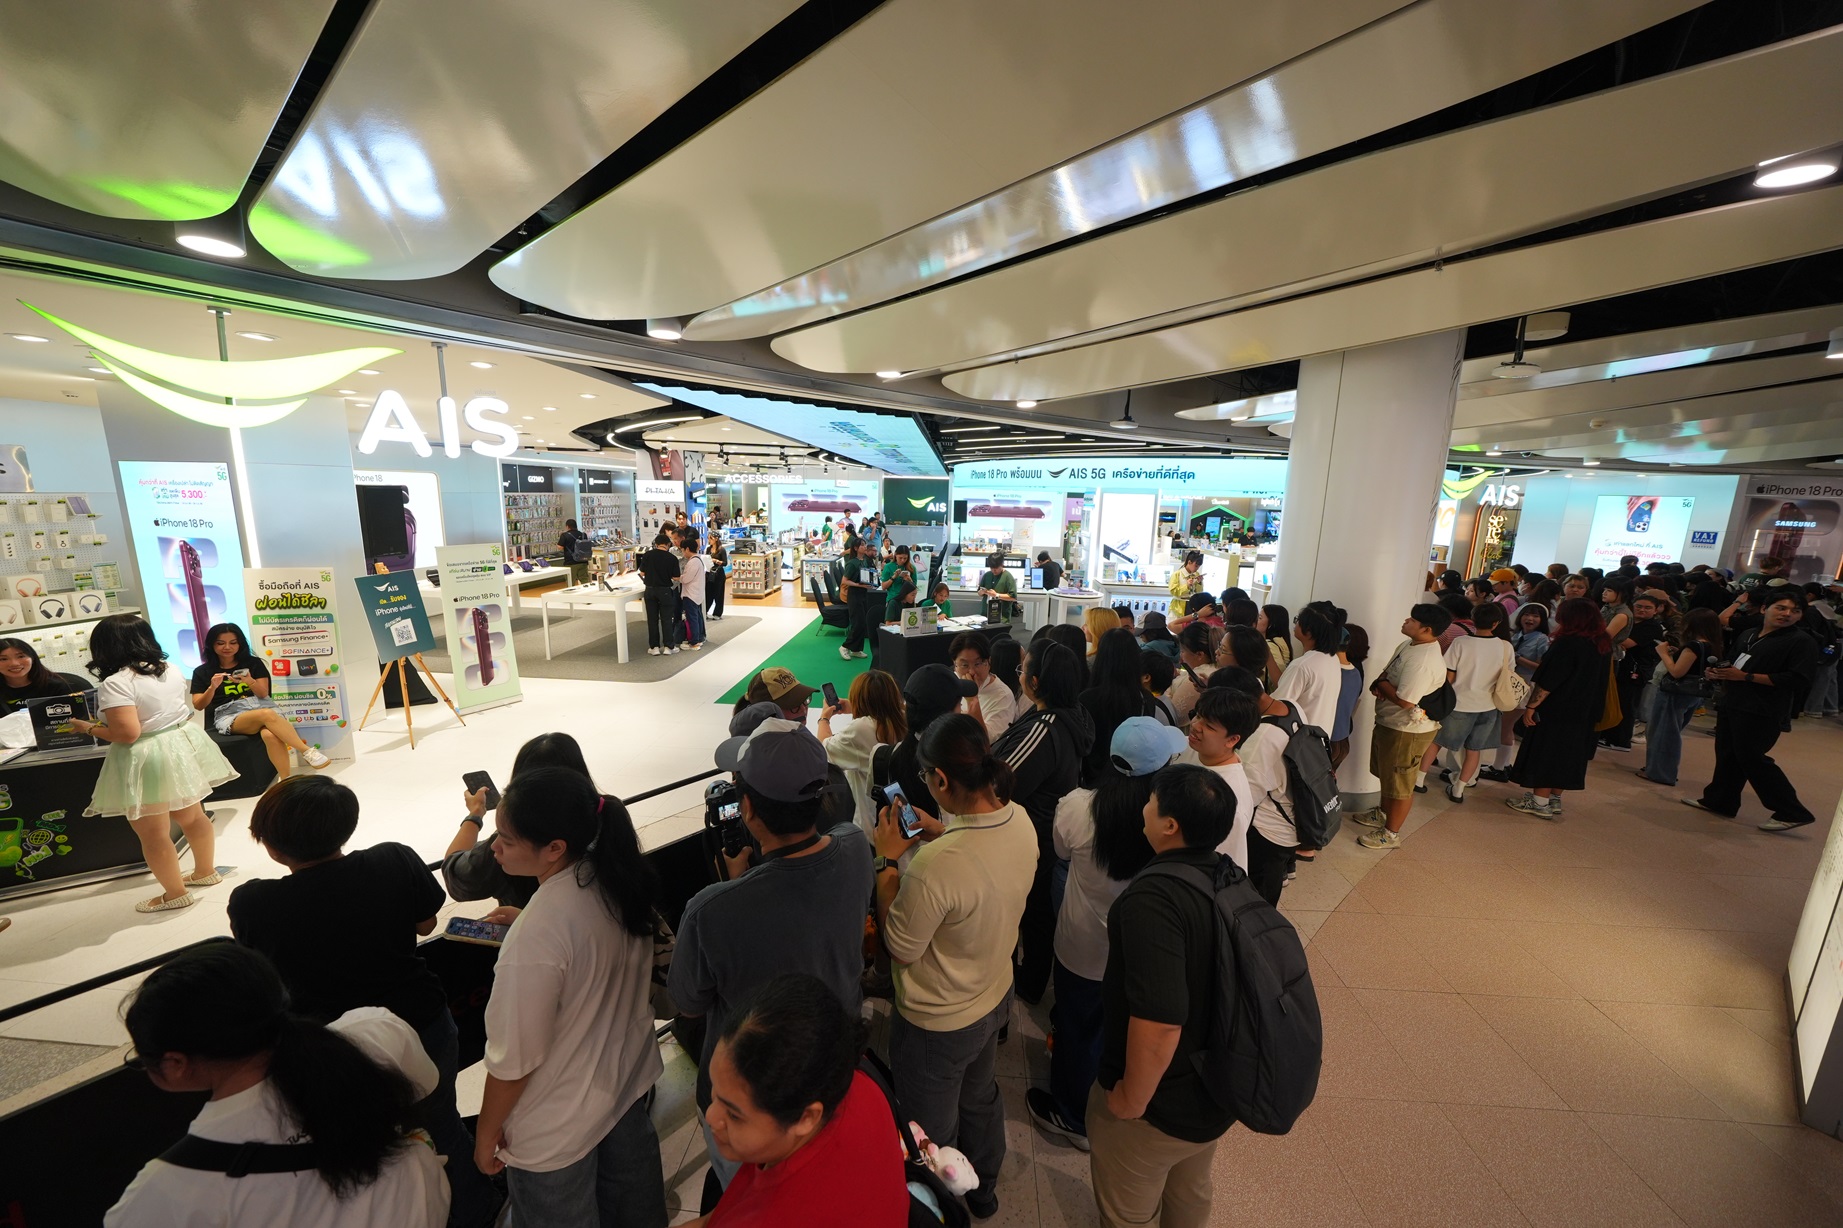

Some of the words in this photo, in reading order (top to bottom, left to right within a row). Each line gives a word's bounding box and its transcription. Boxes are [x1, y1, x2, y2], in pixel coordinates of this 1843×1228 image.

[357, 389, 519, 459] AIS
[216, 471, 228, 481] 5G
[724, 473, 803, 484] ACCESSORIES
[970, 469, 986, 479] iPhone
[987, 469, 995, 479] 18
[996, 469, 1008, 479] Pro
[1010, 466, 1042, 479] พร้อมบน
[1069, 468, 1088, 479] AIS
[1090, 468, 1106, 480] 5G
[1112, 465, 1195, 484] เครือข่ายที่ดีที่สุด
[1478, 484, 1520, 506] AIS
[1765, 485, 1807, 495] iPhone
[1808, 486, 1822, 496] 18
[1823, 486, 1843, 497] Pro
[927, 502, 947, 512] AIS
[159, 518, 188, 528] iPhone
[188, 518, 199, 528] 18
[199, 519, 214, 529] Pro
[1774, 520, 1817, 528] SAMSUNG
[491, 548, 500, 556] 5G
[321, 574, 331, 582] 5G
[258, 579, 302, 590] ซื้อมือถือที่
[303, 582, 320, 590] AIS
[375, 606, 399, 616] iPhone
[268, 635, 299, 644] Samsung
[224, 682, 250, 696] 5G
